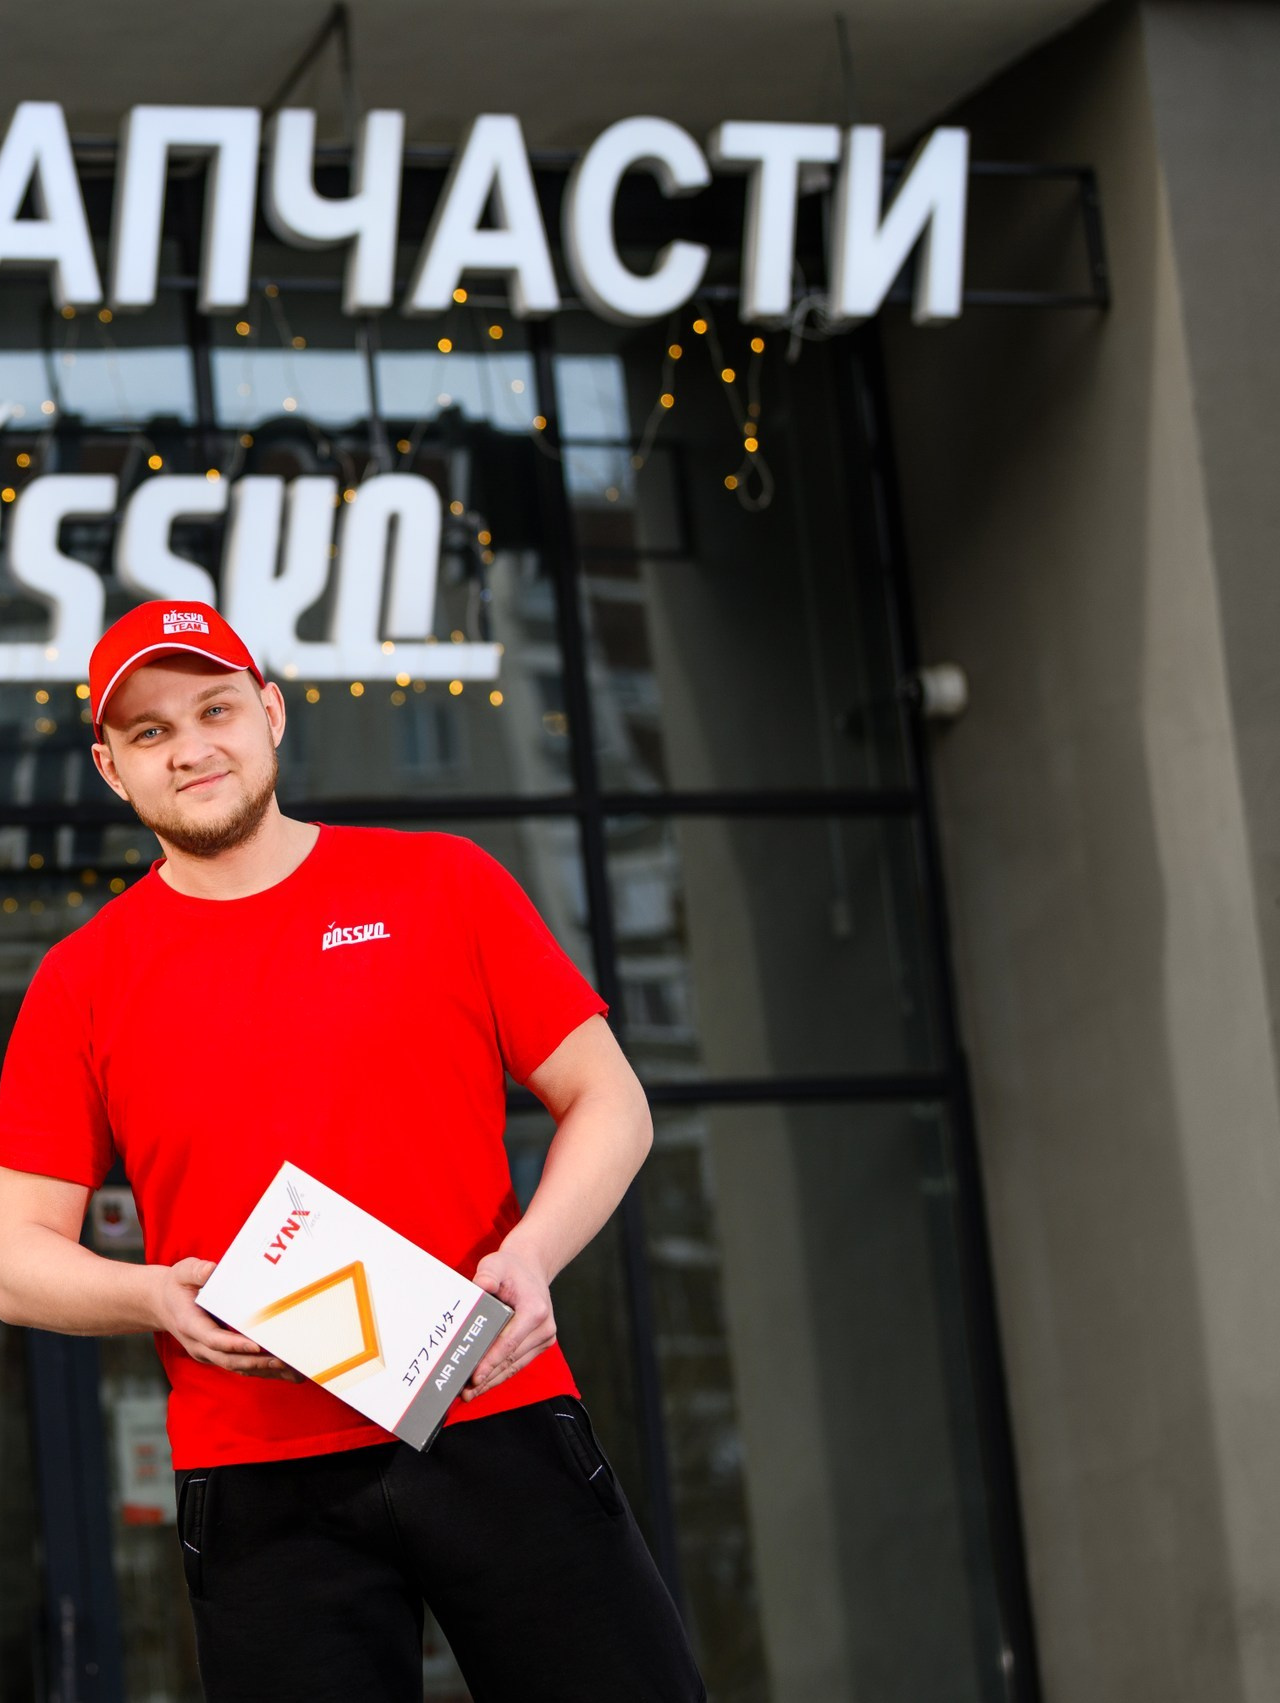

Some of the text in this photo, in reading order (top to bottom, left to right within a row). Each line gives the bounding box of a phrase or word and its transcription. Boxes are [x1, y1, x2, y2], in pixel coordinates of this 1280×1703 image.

[163, 610, 208, 625] ROSSKO
[171, 622, 202, 632] TEAM
[322, 921, 391, 951] ROSSKO
[263, 1180, 314, 1265] LYNX
[434, 1314, 488, 1392] AIR FILTER
